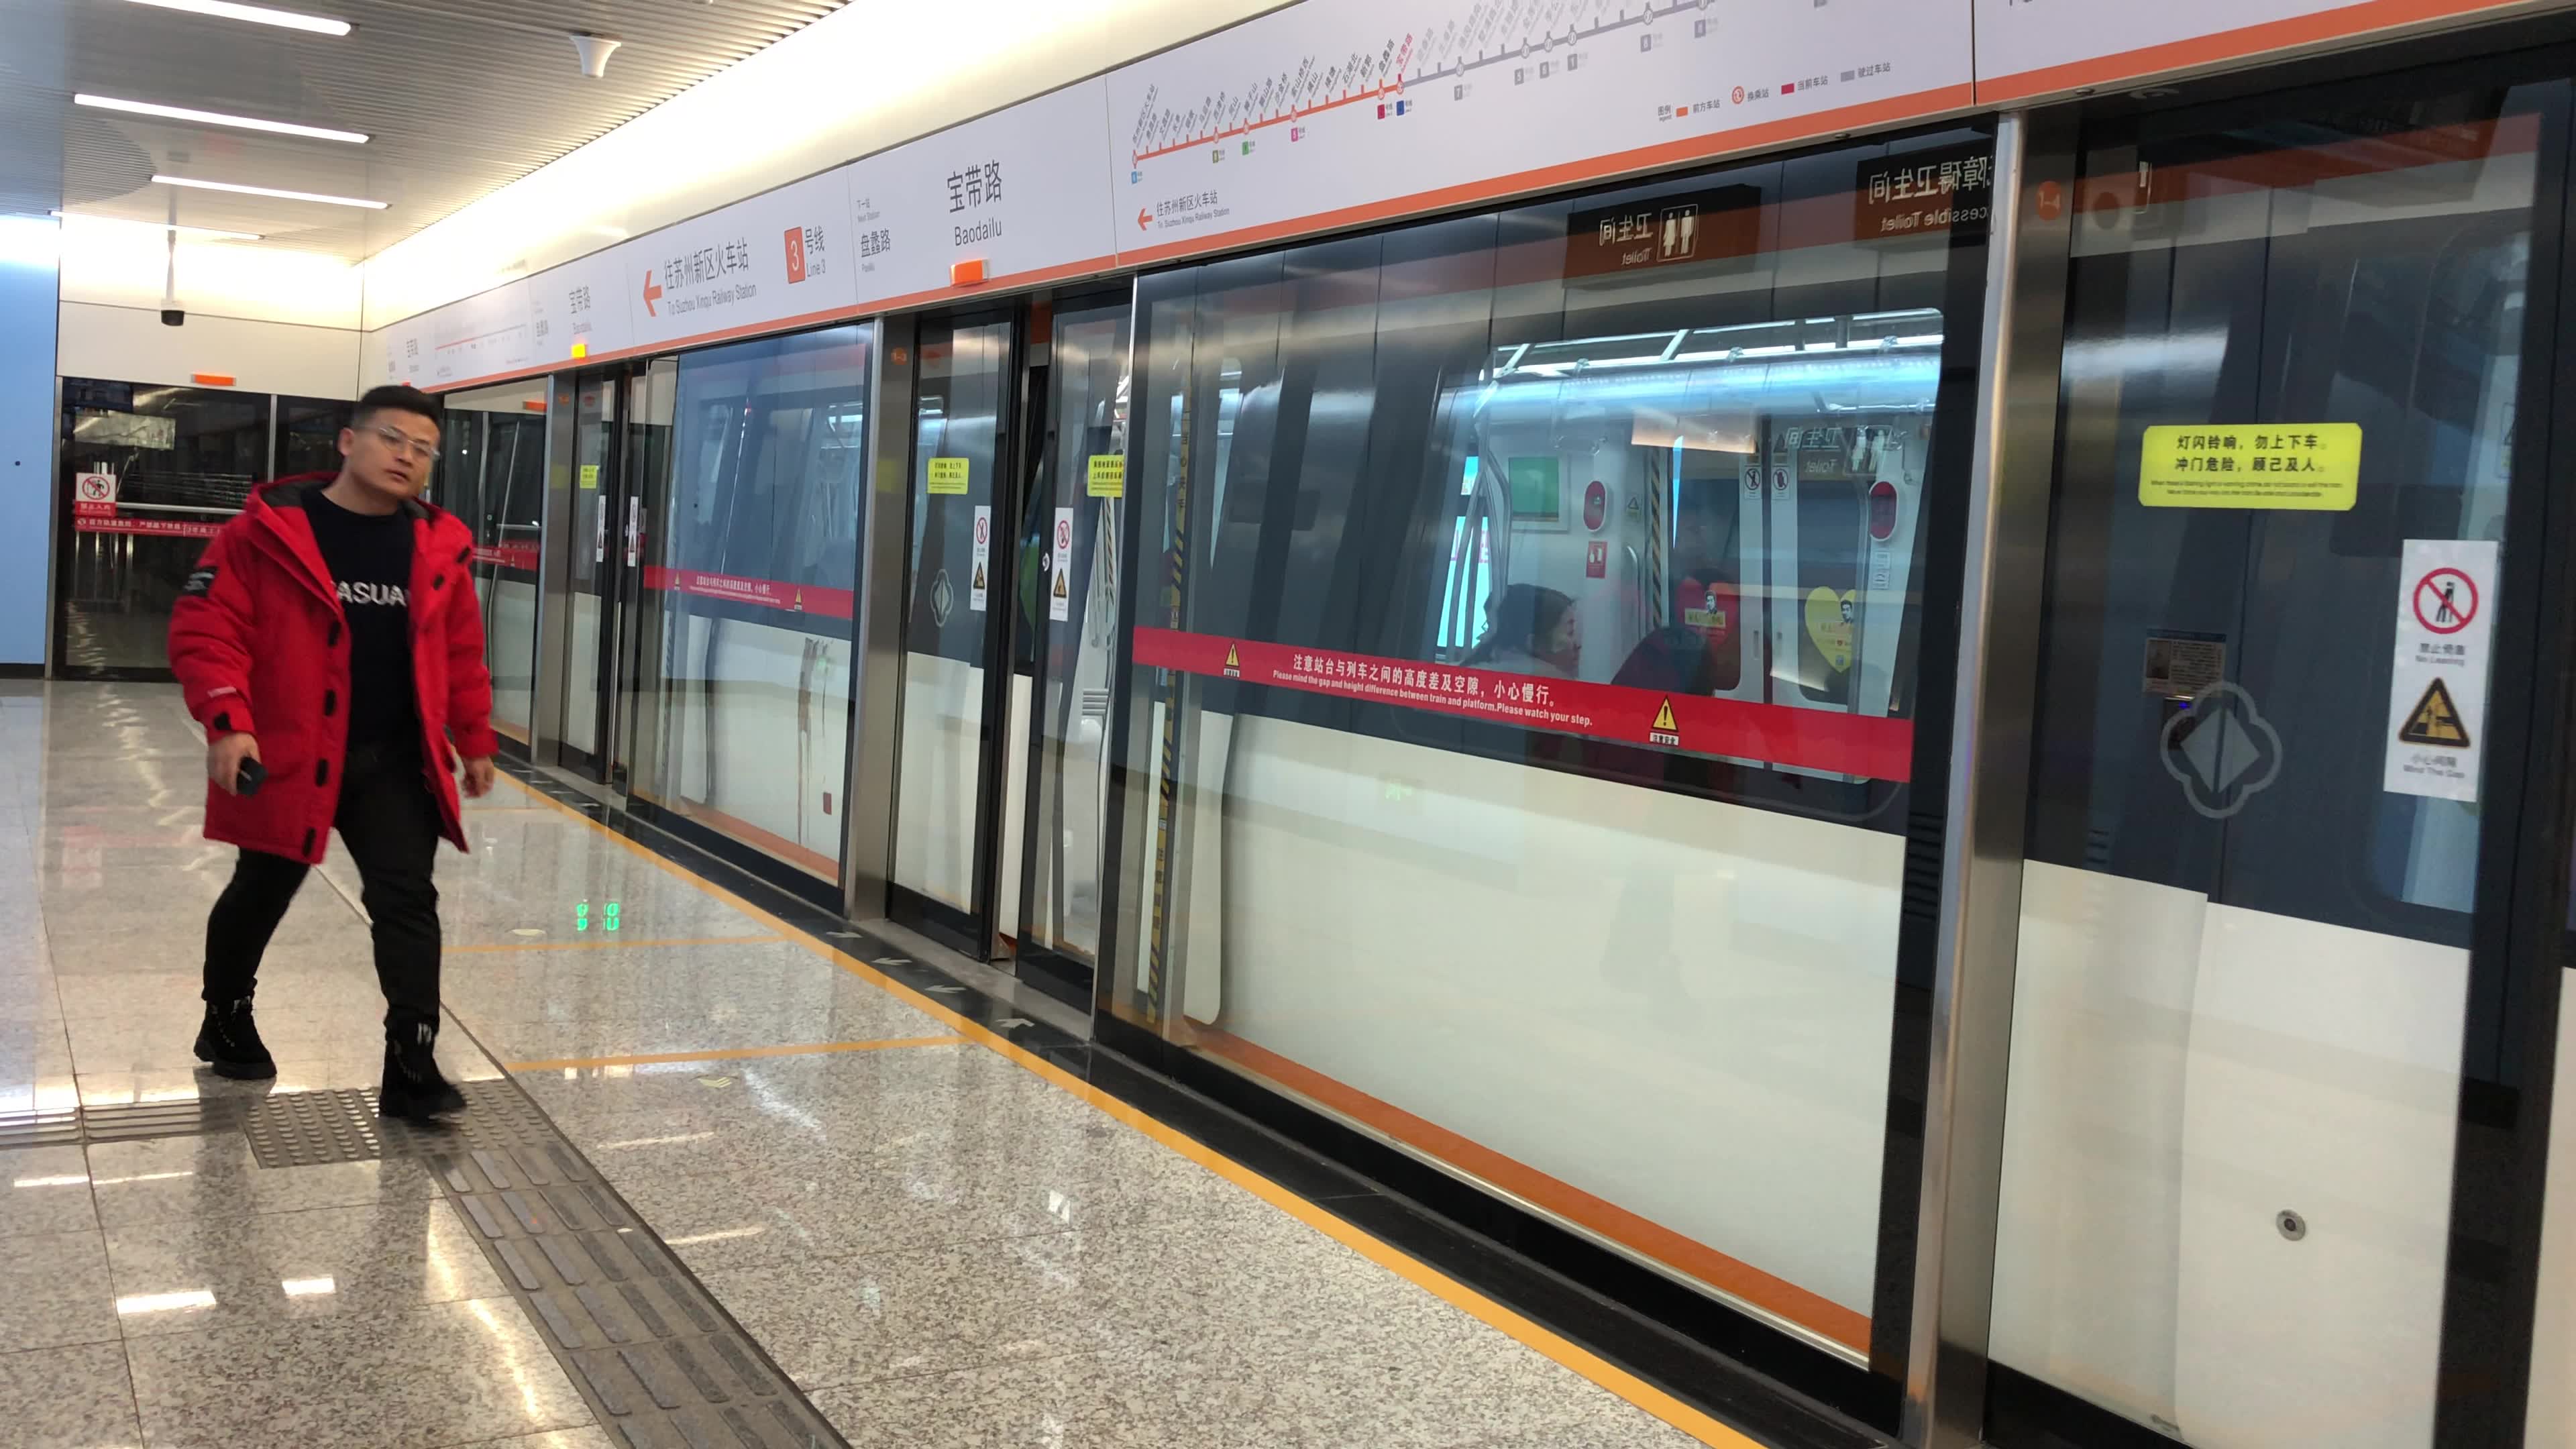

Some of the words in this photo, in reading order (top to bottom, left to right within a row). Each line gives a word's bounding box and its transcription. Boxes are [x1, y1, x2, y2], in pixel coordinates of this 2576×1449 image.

[1658, 105, 1671, 116] 图例
[947, 159, 1002, 213] 宝带路
[1157, 189, 1218, 217] 往苏州新区火车站
[805, 225, 825, 254] 号线
[861, 228, 891, 258] 盘蠡路
[954, 217, 1002, 246] Baodailu
[665, 237, 749, 290] 往苏州新区火车站
[790, 241, 800, 271] 3
[806, 262, 820, 278] Line
[676, 299, 695, 314] Suzhou
[712, 289, 734, 306] Railway
[735, 283, 757, 300] Station
[331, 580, 411, 606] ASUA
[1273, 669, 1292, 680] Please
[1293, 674, 1307, 683] mind
[1308, 675, 1318, 684] the
[1319, 678, 1330, 688] gap
[1331, 680, 1342, 689] and
[1344, 681, 1363, 692] height
[1364, 684, 1398, 697] difference
[1399, 689, 1429, 702] between
[1430, 693, 1446, 704] train
[1448, 696, 1461, 706] and
[1524, 708, 1549, 720] watch
[1550, 711, 1570, 722] your
[1571, 714, 1593, 728] step.
